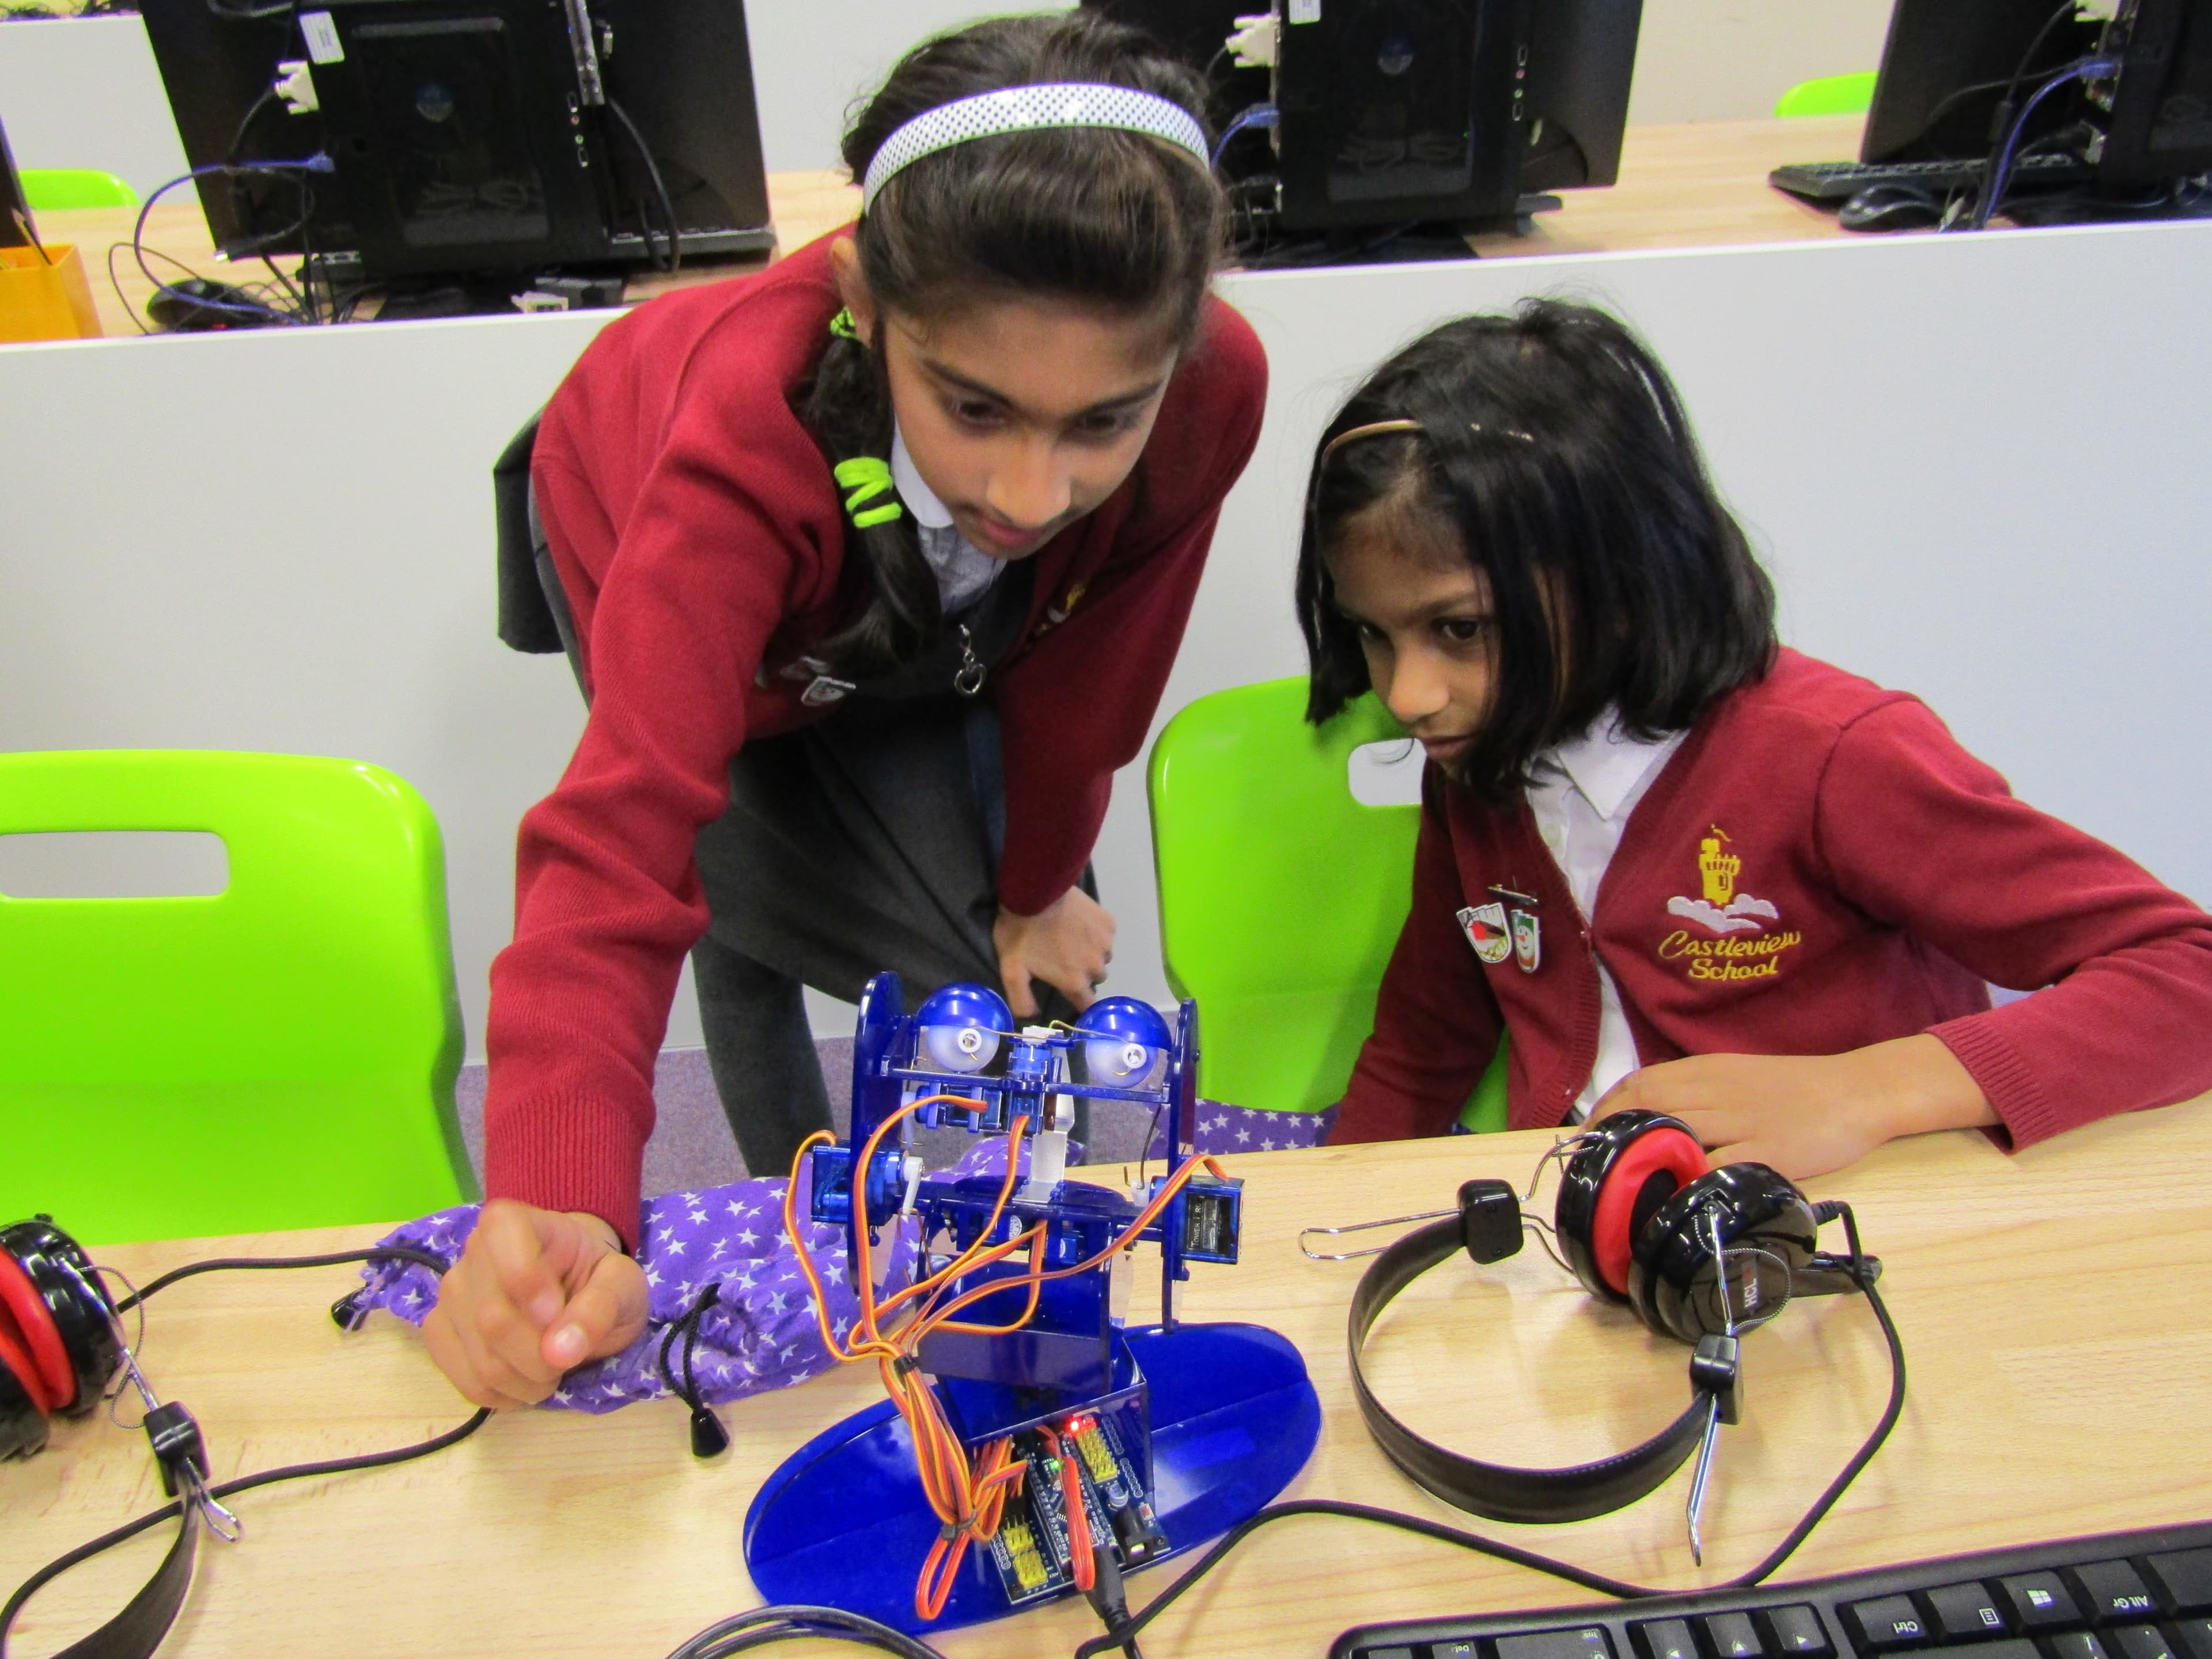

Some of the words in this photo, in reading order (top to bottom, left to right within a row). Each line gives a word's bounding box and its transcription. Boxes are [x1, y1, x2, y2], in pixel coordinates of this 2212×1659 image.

[1658, 930, 1801, 960] Castleview
[1688, 955, 1779, 982] School
[1893, 1620, 1918, 1634] Ctrl
